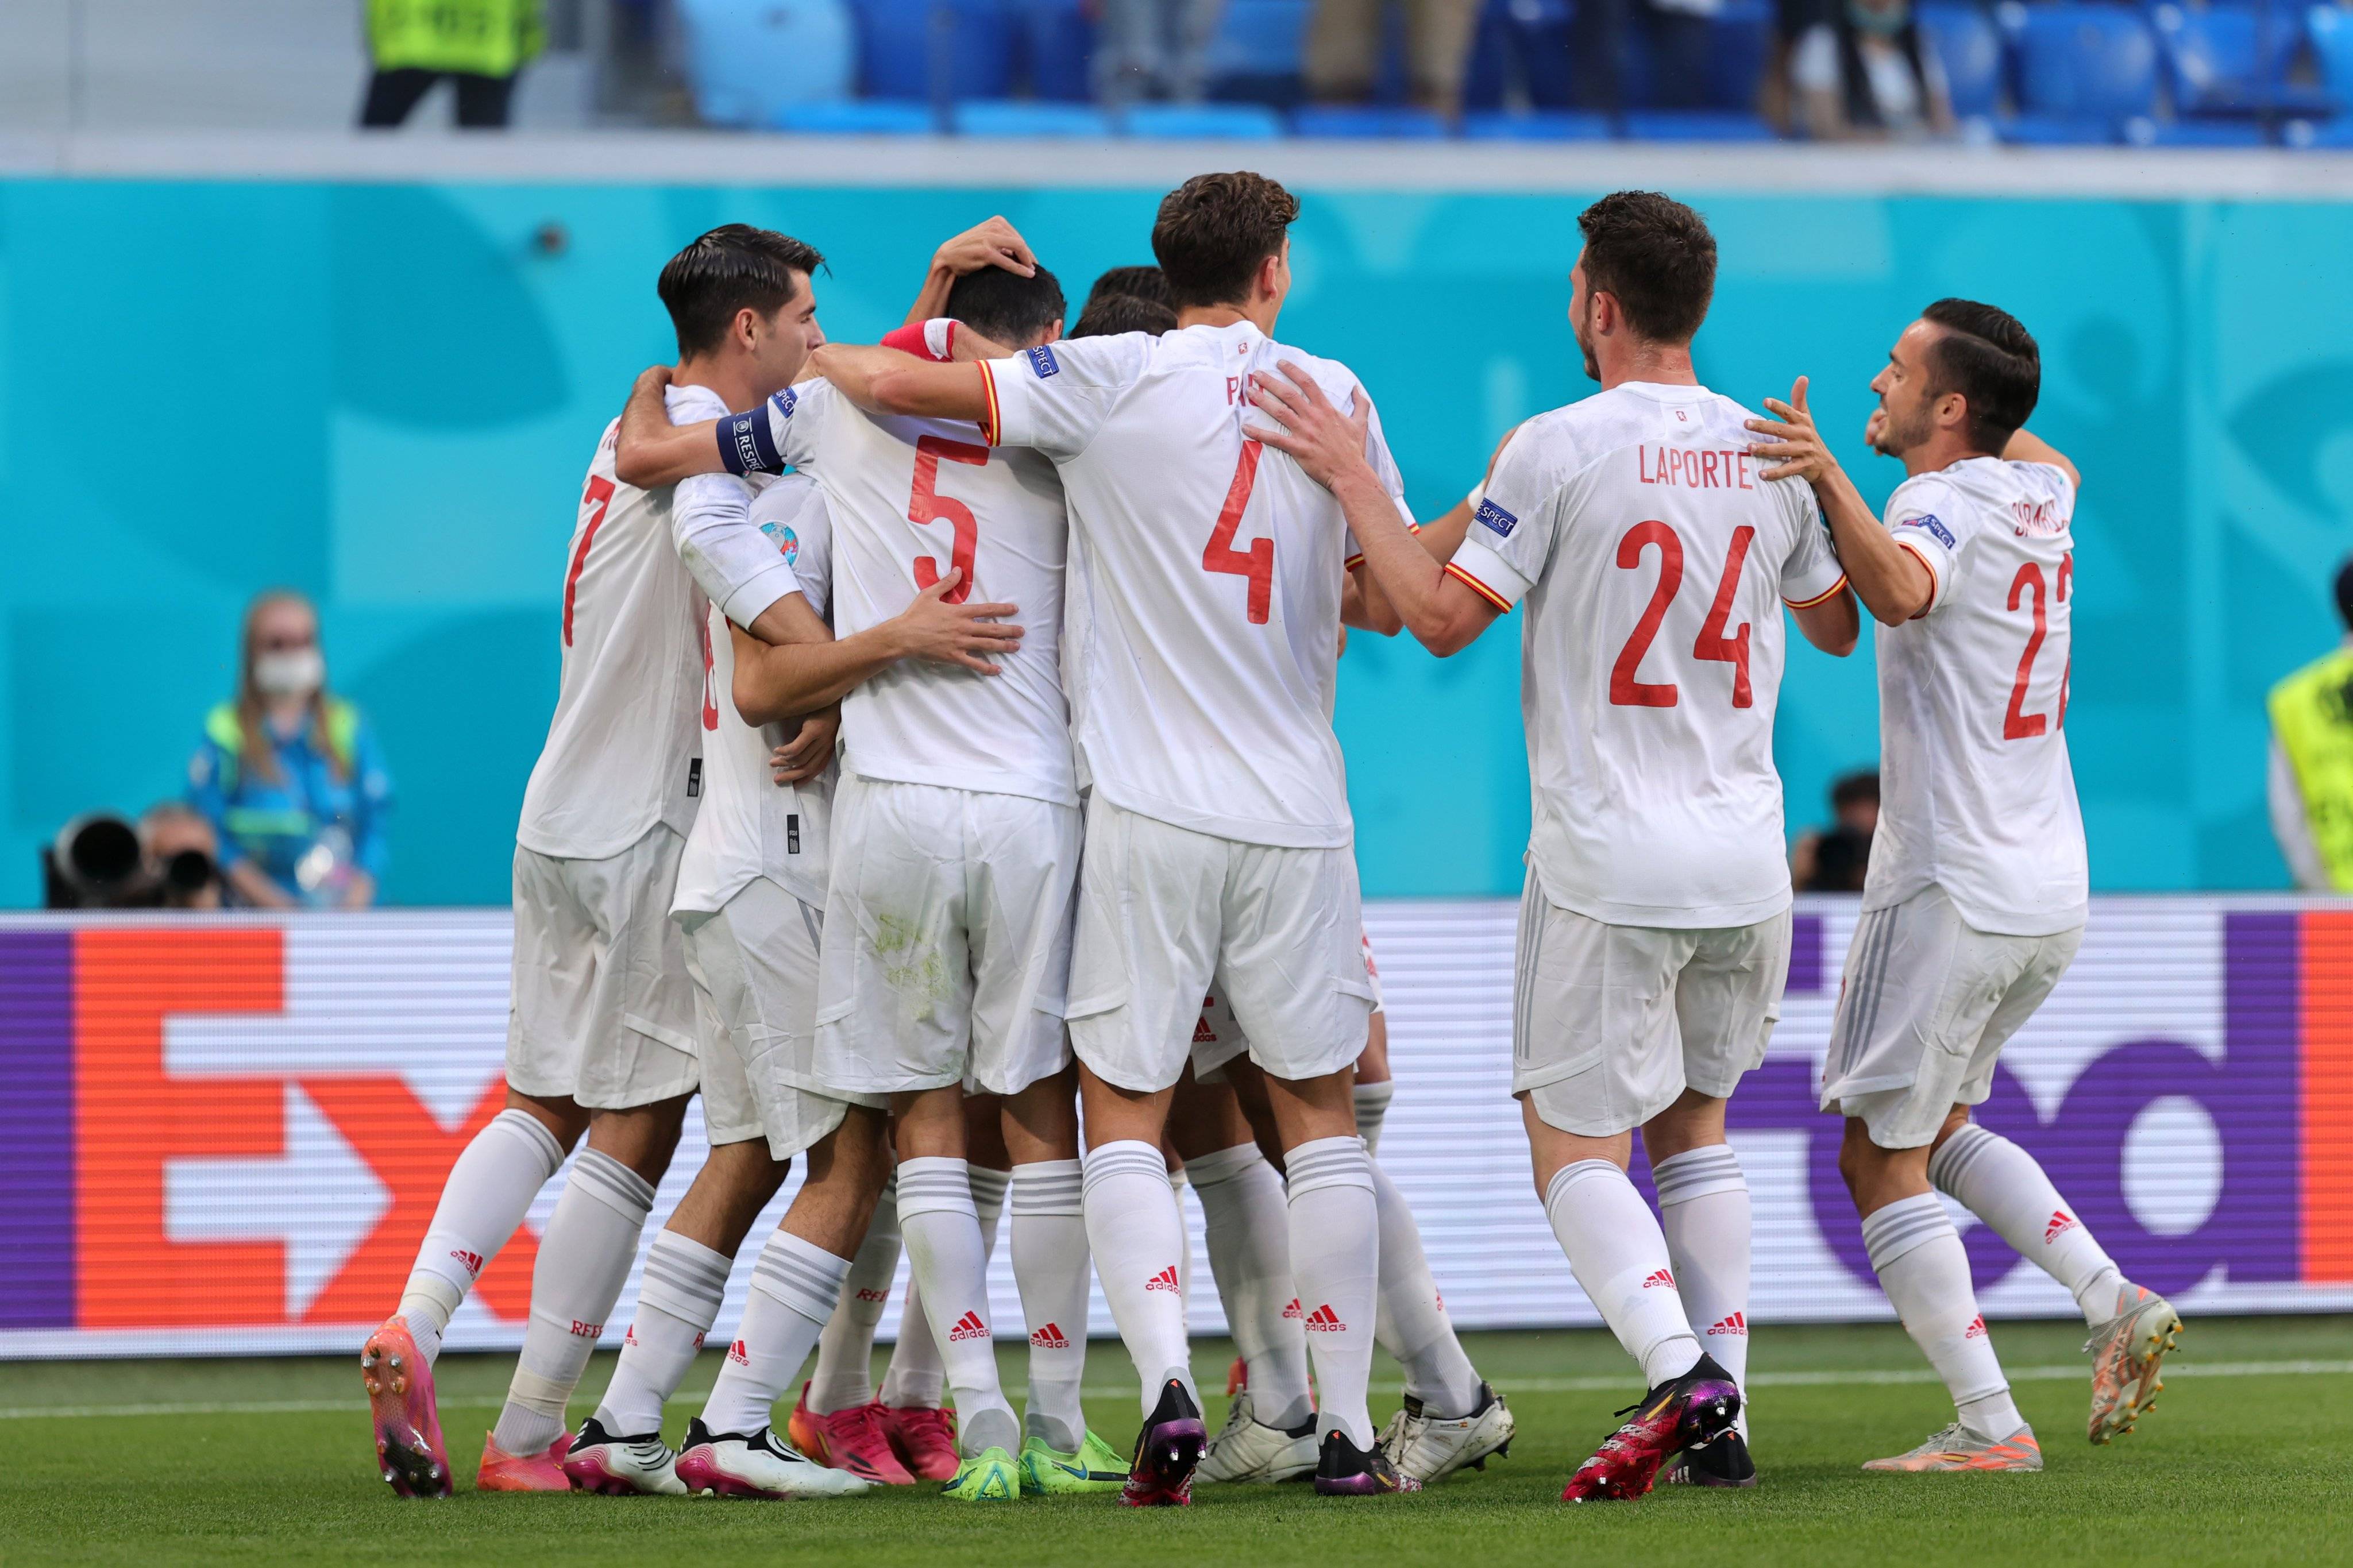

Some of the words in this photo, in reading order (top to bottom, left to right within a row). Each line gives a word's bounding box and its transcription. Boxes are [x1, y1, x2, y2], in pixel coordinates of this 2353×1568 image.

[1032, 346, 1054, 374] SPECT
[776, 389, 796, 412] SPECT
[1639, 445, 1753, 489] LAPORTE
[908, 435, 989, 604] 5
[1202, 440, 1274, 624] 4
[562, 474, 615, 647] 7
[1609, 520, 1755, 708] 24
[950, 1328, 990, 1342] adidas
[1030, 1337, 1070, 1349] adidas
[1305, 1323, 1347, 1332] adidas
